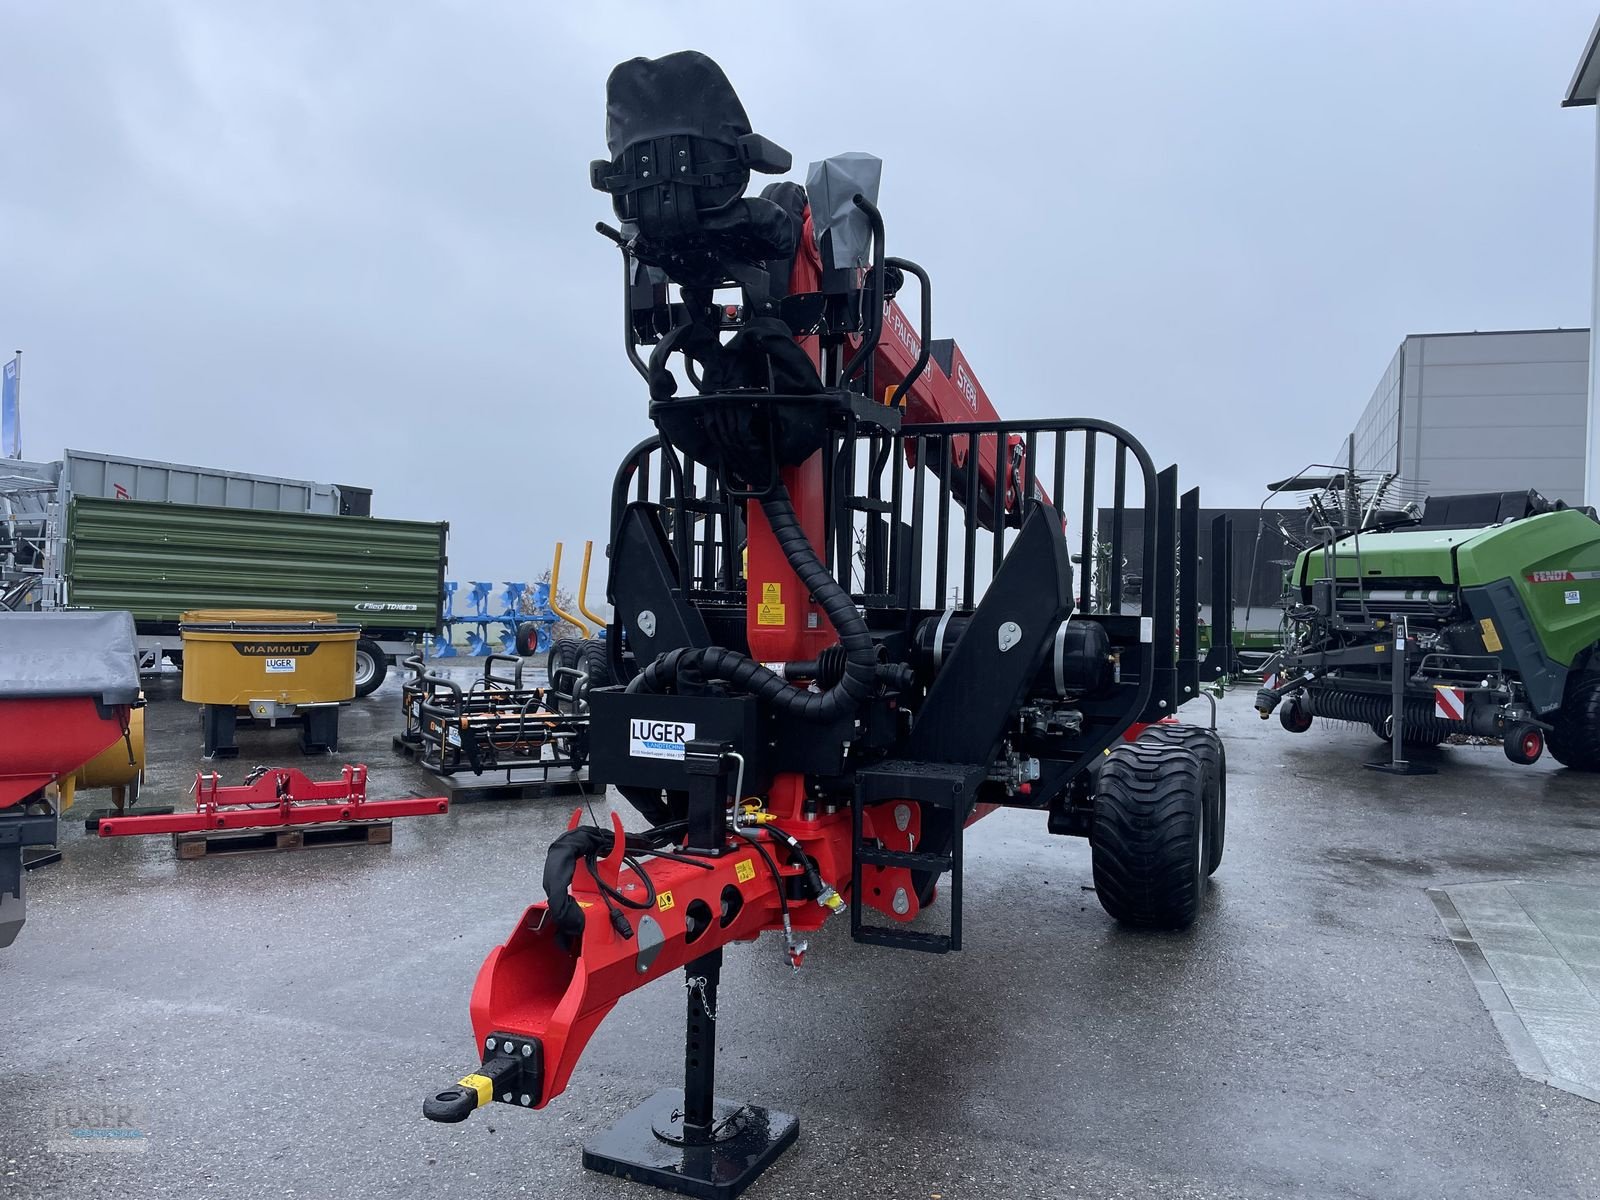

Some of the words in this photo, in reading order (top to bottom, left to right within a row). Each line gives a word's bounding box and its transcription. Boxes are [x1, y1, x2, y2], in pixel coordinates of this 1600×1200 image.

[957, 364, 977, 411] STEPA
[1533, 570, 1568, 582] FENDT
[243, 645, 310, 653] MAMMUT
[266, 659, 291, 667] LUGER
[632, 721, 686, 744] LUGER
[647, 742, 686, 751] LANDTECHNI
